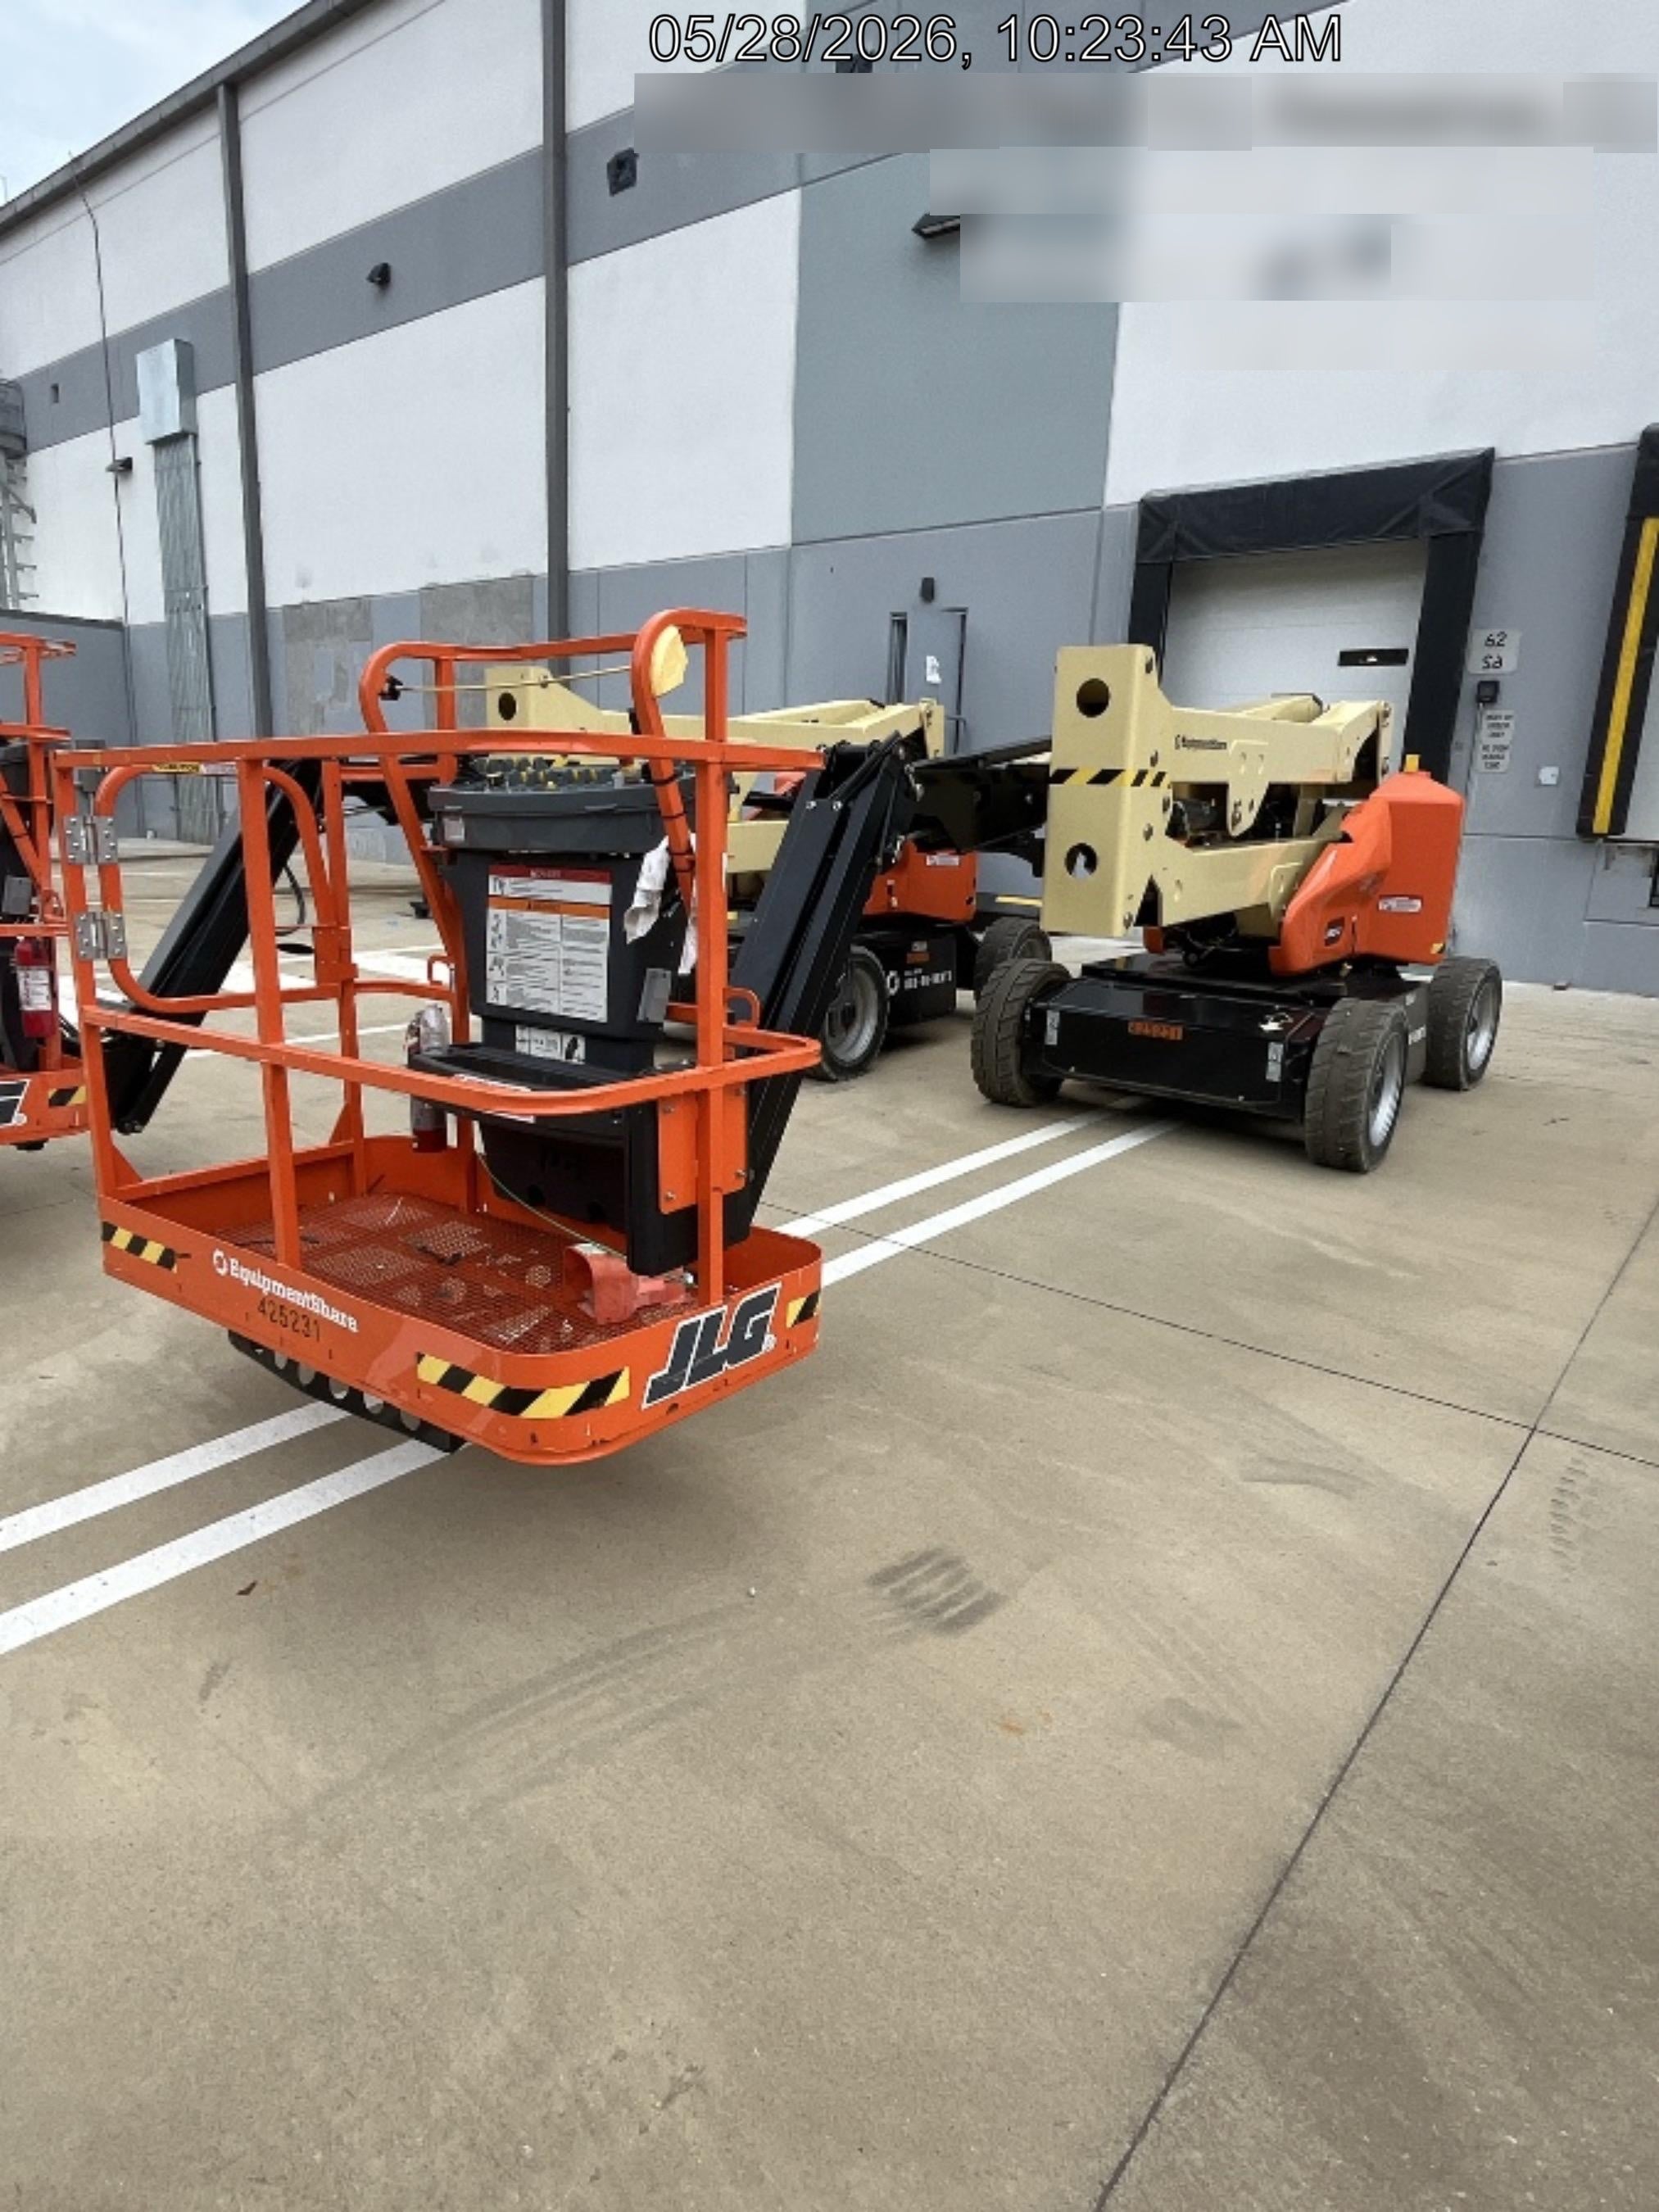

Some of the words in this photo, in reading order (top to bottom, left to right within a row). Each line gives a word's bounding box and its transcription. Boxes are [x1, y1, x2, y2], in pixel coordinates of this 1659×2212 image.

[229, 1258, 359, 1333] EquipmentShare
[256, 1297, 320, 1343] 425231
[641, 1281, 782, 1411] JLG
